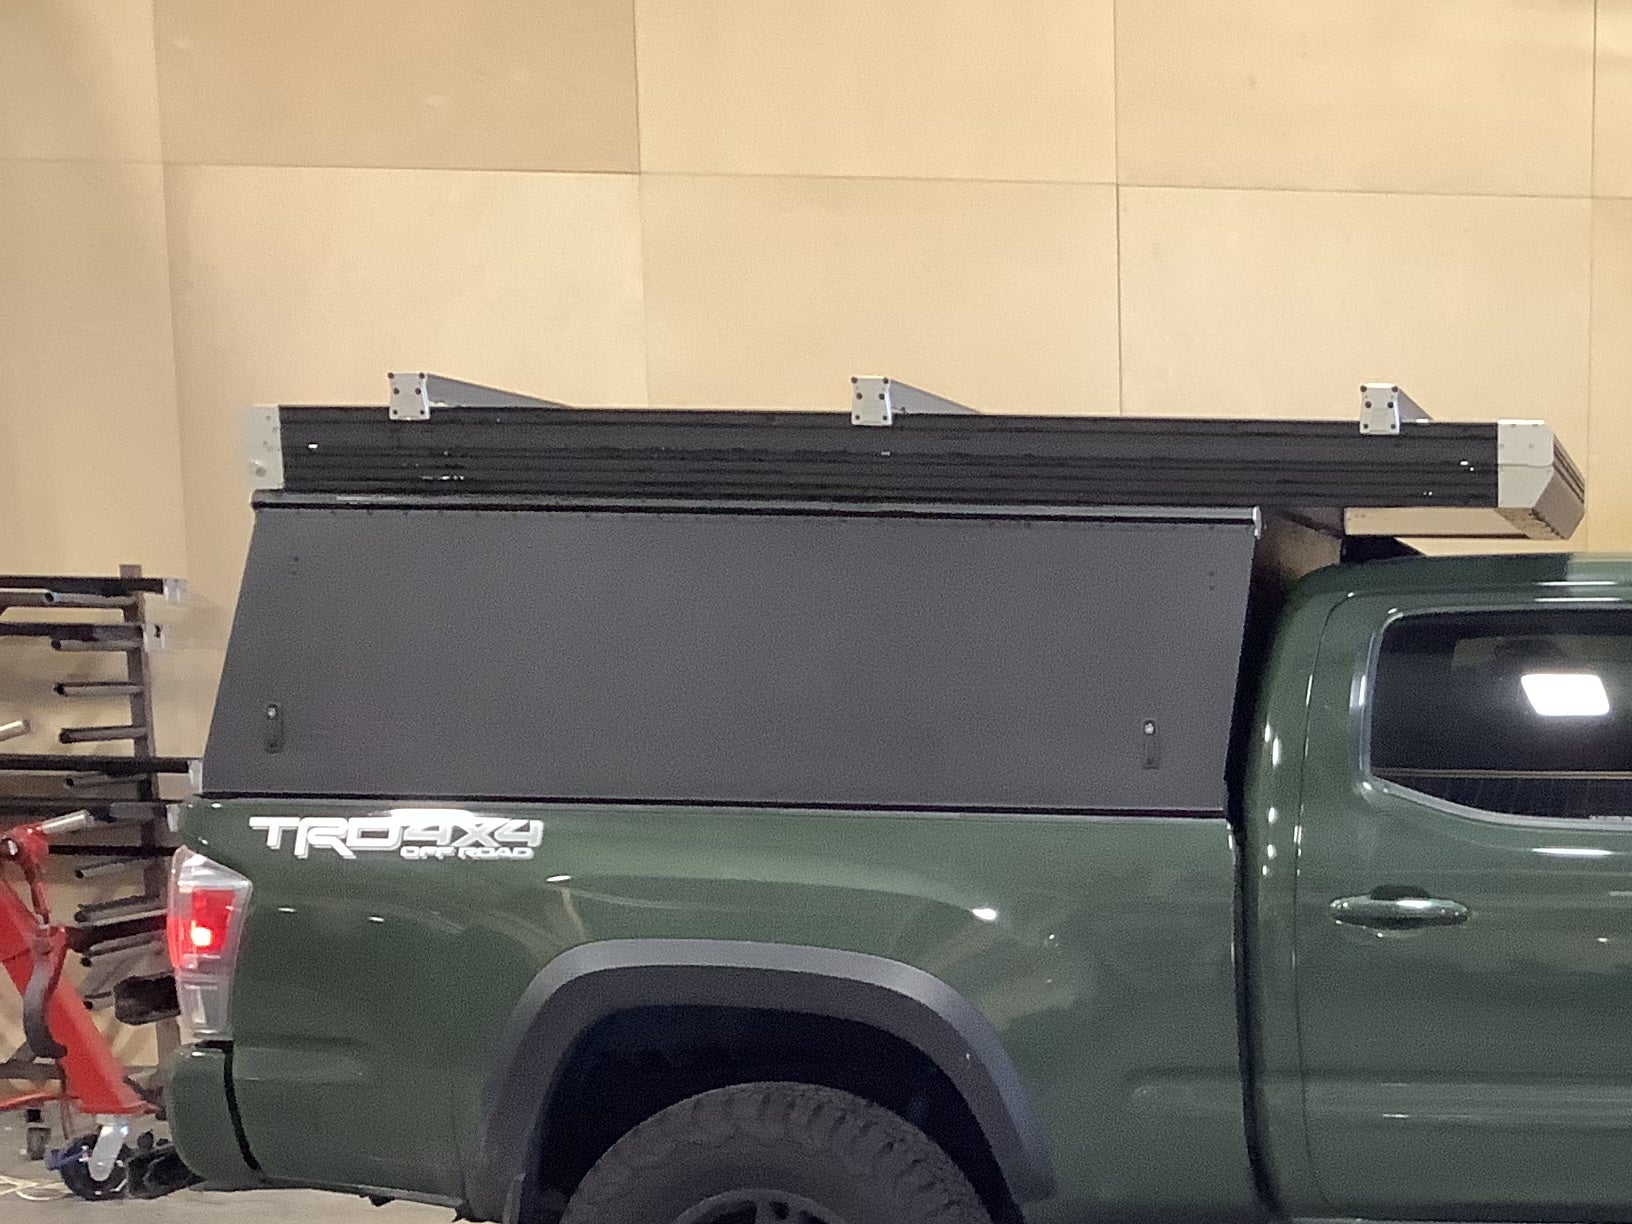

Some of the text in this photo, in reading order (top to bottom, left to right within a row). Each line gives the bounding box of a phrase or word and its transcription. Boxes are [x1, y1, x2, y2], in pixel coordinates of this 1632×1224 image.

[249, 816, 402, 859] TRD
[400, 845, 535, 860] OFF ROAD
